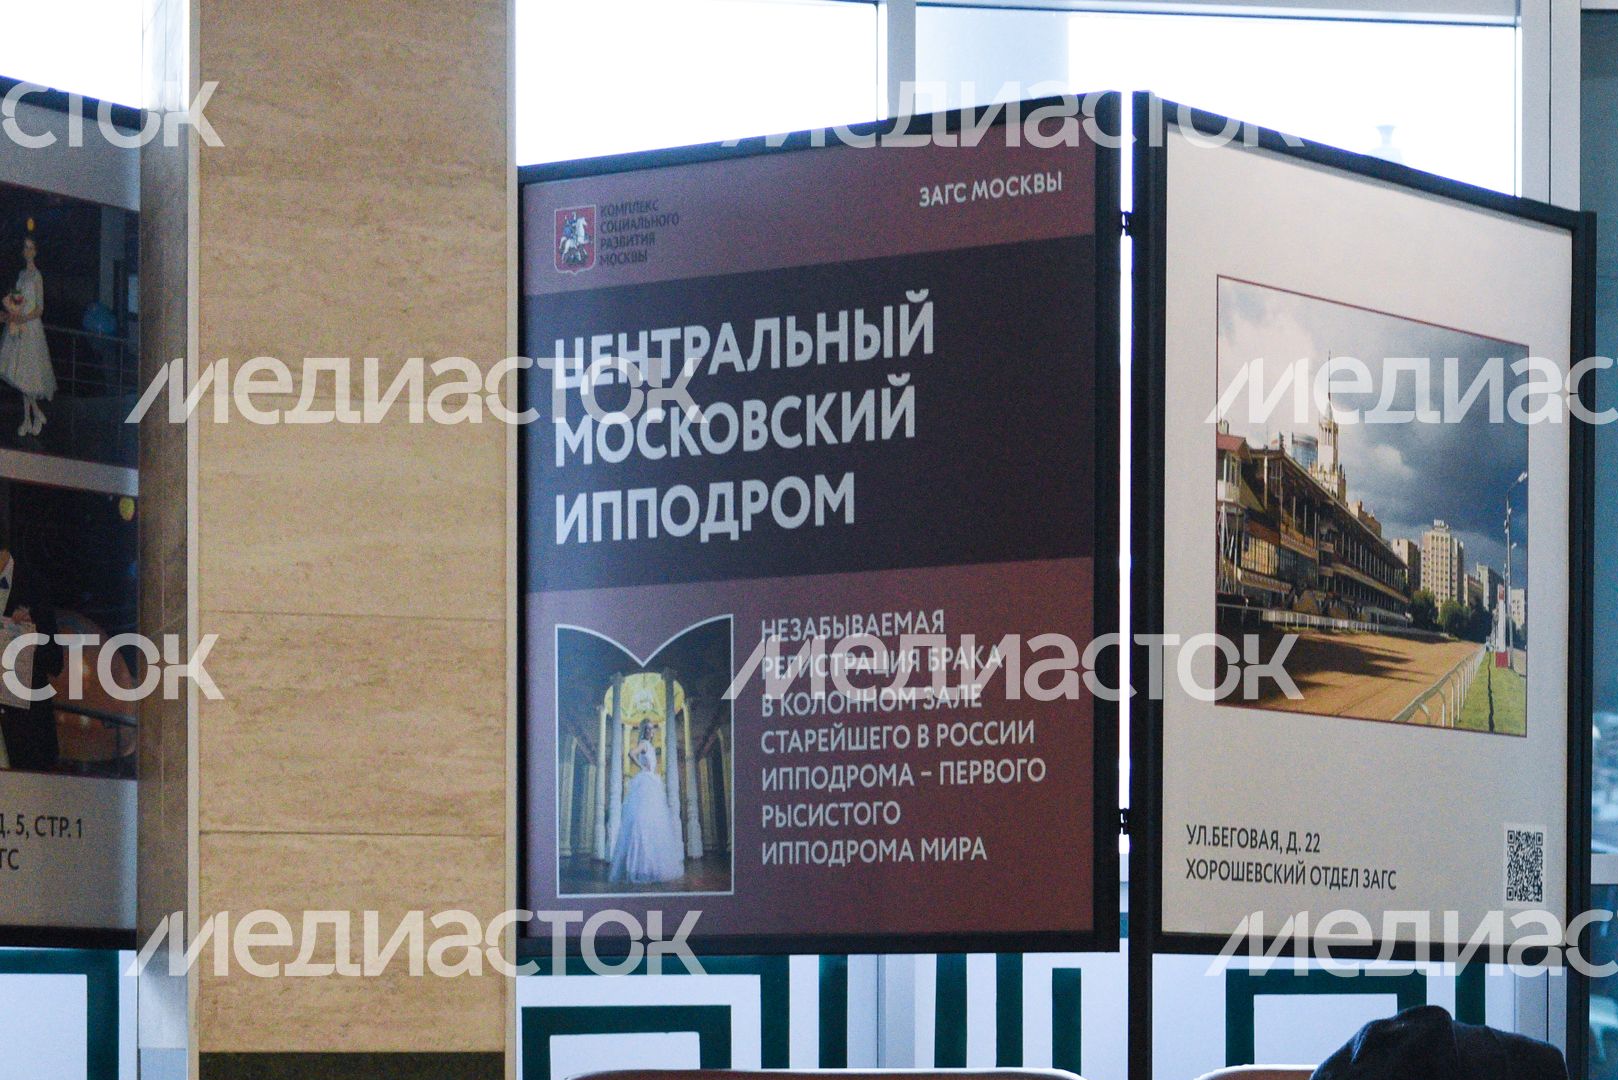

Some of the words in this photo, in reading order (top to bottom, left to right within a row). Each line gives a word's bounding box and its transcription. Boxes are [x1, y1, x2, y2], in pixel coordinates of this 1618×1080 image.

[920, 180, 966, 207] ЗАГС
[973, 170, 1062, 203] МОСКВЫ
[600, 199, 659, 217] КОМПЛЕКС
[600, 212, 679, 233] СОЦИАЛЬНОГО
[600, 232, 655, 249] РАЗВИТИЯ
[600, 249, 647, 265] МОСКВЫ
[555, 288, 935, 395] ЦЕНТРАЛЬНЫЙ
[555, 372, 916, 467] МОСКОВСКИЙ
[555, 472, 854, 545] ИППОДРОМ
[761, 609, 945, 642] НЕЗАБЫВАЕМАЯ
[761, 646, 922, 683] РЕГИСТРАЦИЯ
[928, 644, 1003, 672] БРАКА
[762, 695, 774, 717] В
[780, 688, 917, 717] КОЛОННОМ
[923, 683, 981, 709] ЗАЛЕ
[761, 722, 910, 755] СТАРЕЙШЕГО
[917, 725, 930, 748] В
[938, 720, 1035, 747] РОССИИ
[761, 762, 914, 793] ИППОДРОМА
[940, 758, 1046, 786] ПЕРВОГО
[16, 815, 29, 840] 5,
[34, 815, 71, 838] СТР.
[76, 818, 83, 838] 1
[761, 801, 901, 828] РЫСИСТОГО
[761, 839, 914, 868] ИППОДРОМА
[922, 837, 988, 862] МИРА
[1185, 824, 1283, 855] УЛ.БЕГОВАЯ,
[1286, 832, 1302, 857] Д.
[1304, 831, 1321, 853] 22
[1185, 858, 1306, 886] ХОРОШЕВСКИЙ
[1310, 865, 1359, 891] ОТДЕЛ
[1362, 867, 1397, 890] ЗАГС
